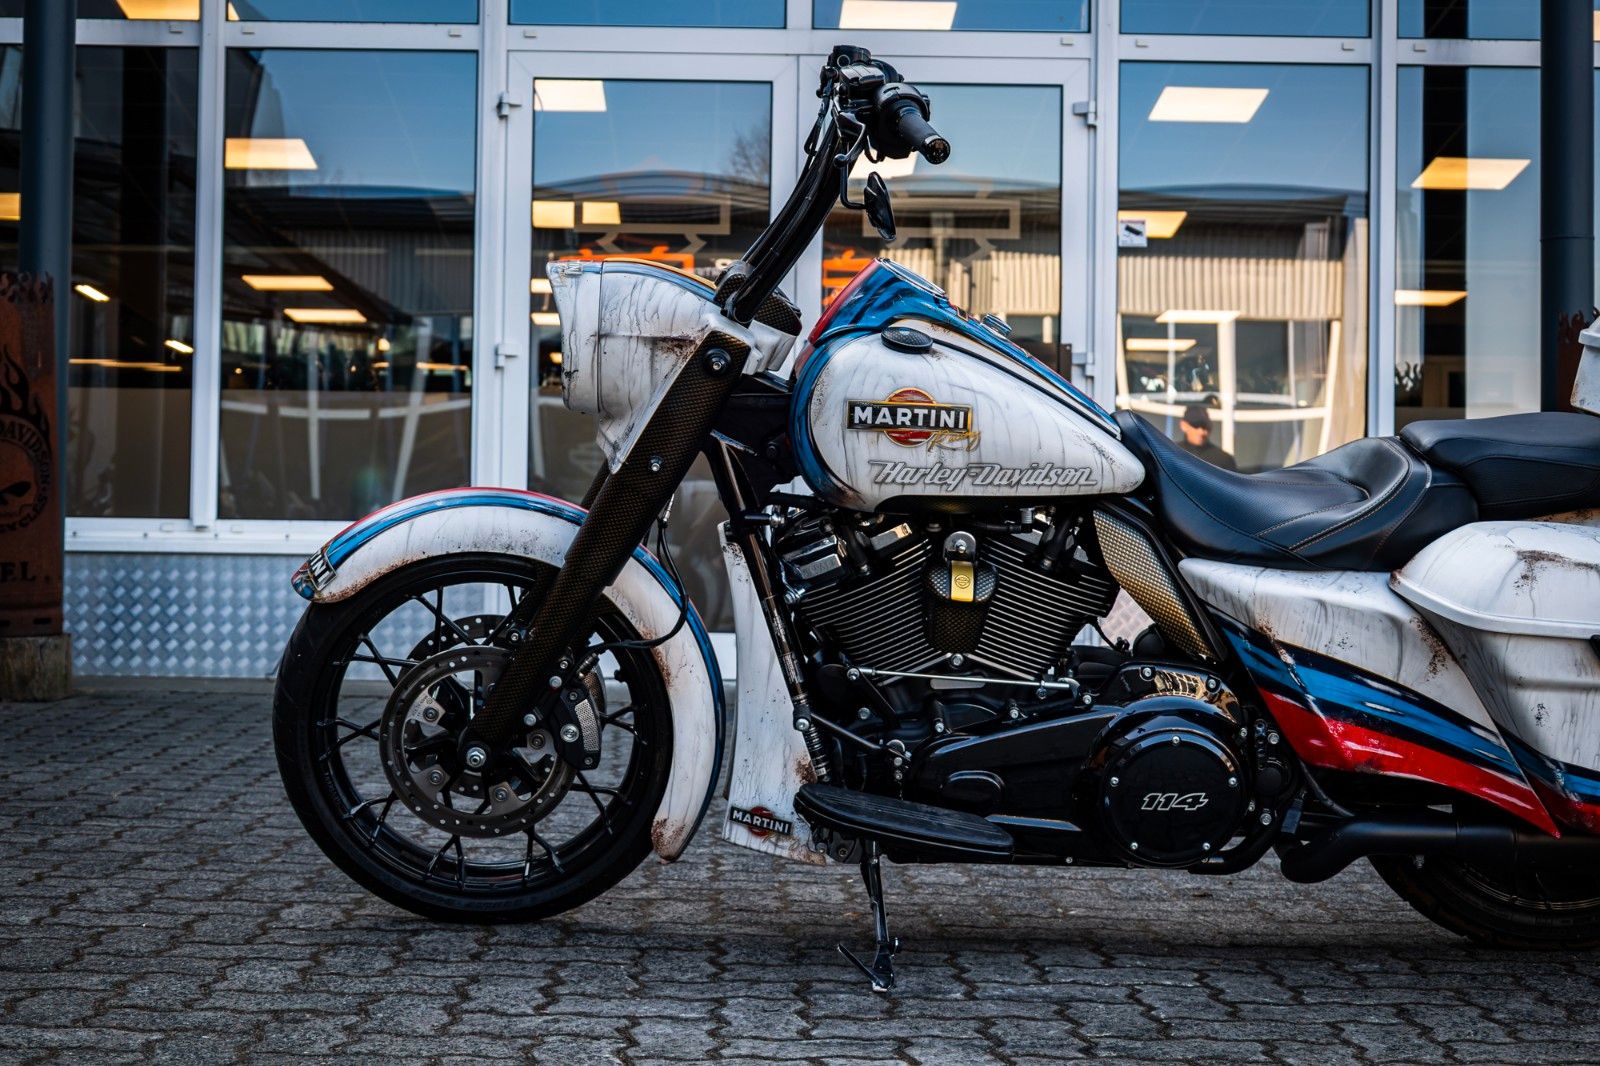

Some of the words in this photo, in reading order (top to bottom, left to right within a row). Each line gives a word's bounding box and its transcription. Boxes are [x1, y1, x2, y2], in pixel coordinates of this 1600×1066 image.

[854, 405, 965, 429] MARTINI
[868, 460, 1098, 491] Harley-Davidson
[1141, 792, 1209, 811] 114
[732, 809, 789, 833] MARTINI
